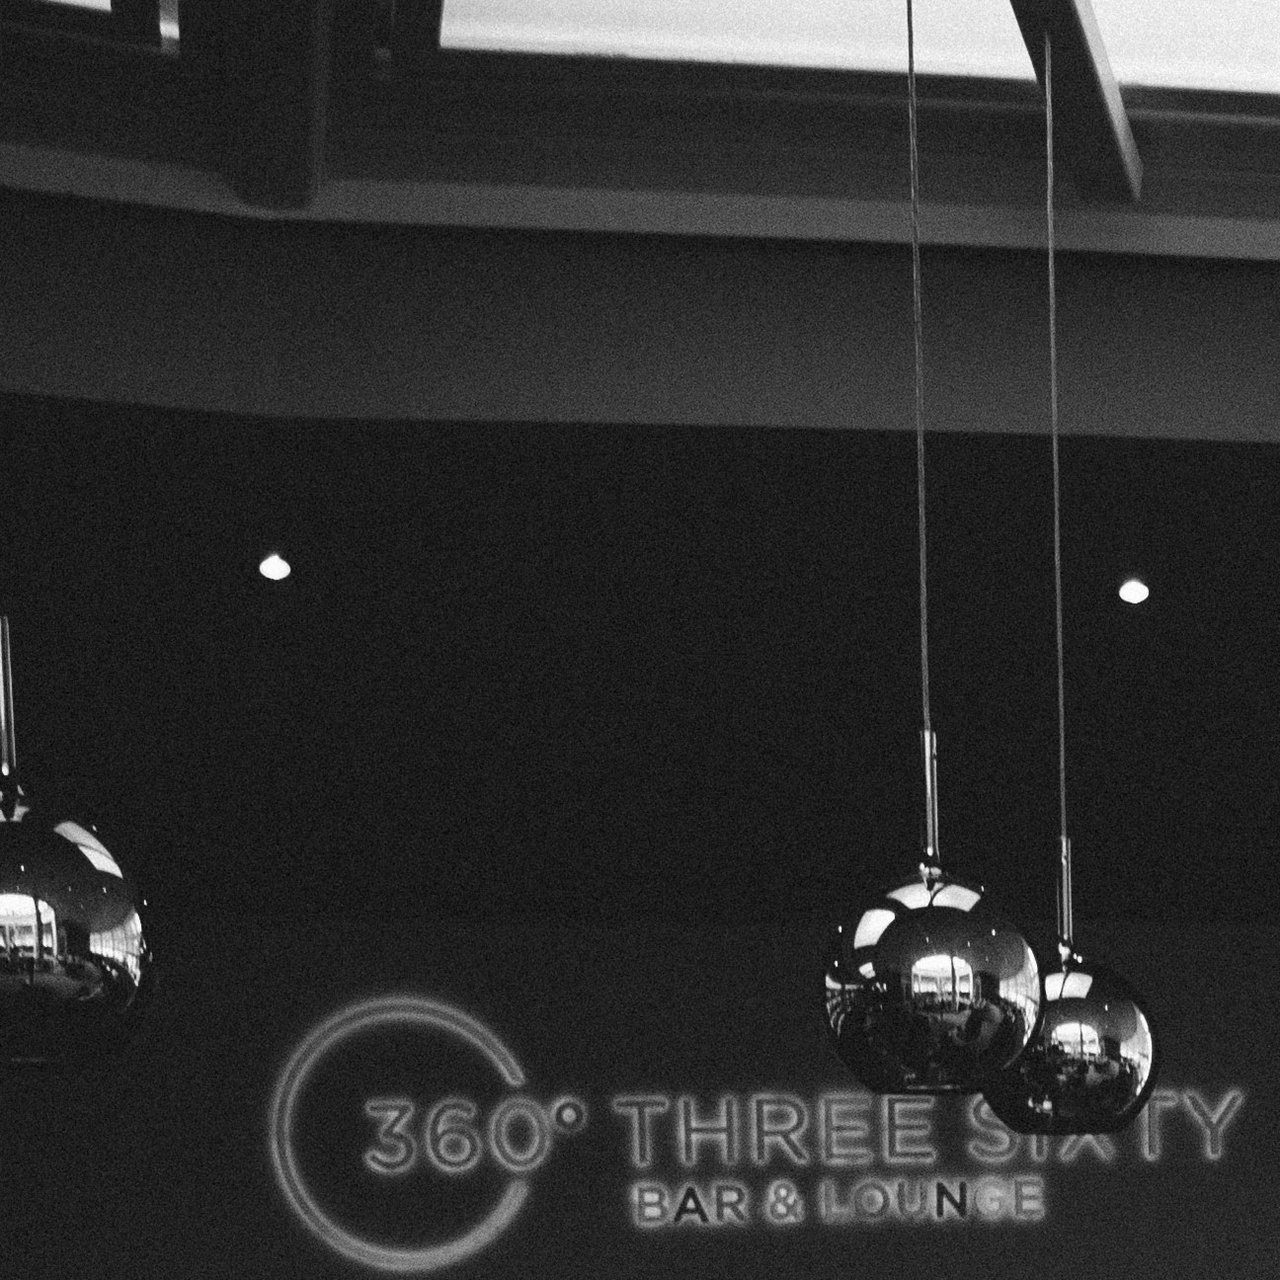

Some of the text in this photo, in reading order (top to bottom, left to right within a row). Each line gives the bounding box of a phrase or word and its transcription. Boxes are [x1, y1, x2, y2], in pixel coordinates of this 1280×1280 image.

[612, 1093, 937, 1166] THREE
[631, 1178, 1046, 1226] BAR & LOUNGE
